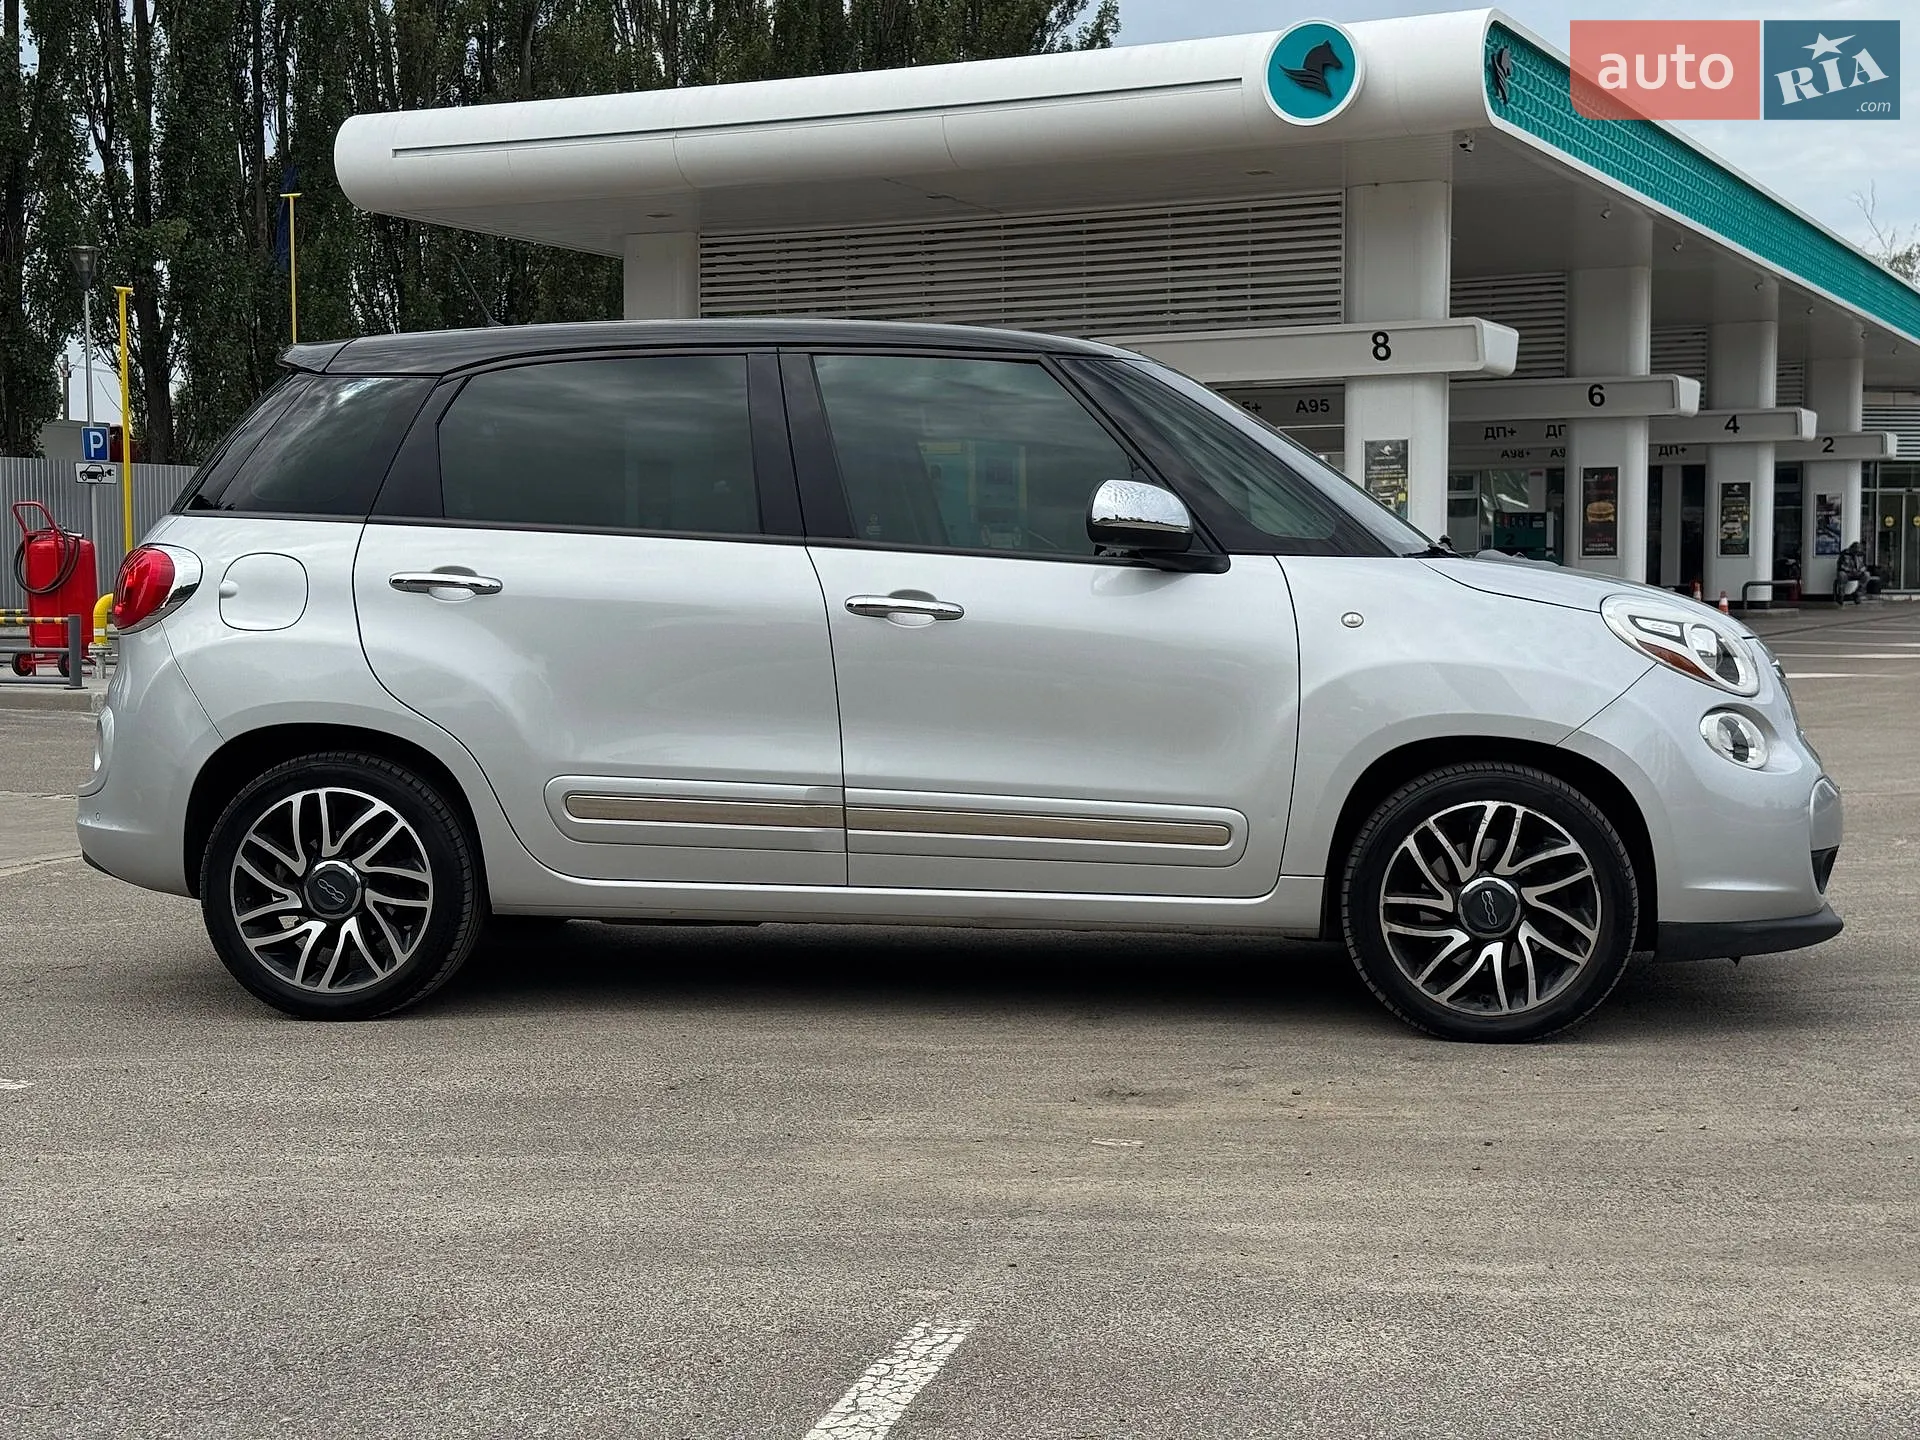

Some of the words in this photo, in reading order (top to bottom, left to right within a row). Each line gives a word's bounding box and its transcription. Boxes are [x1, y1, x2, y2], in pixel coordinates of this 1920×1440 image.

[1371, 331, 1392, 362] 8
[1587, 384, 1606, 408] 6
[1484, 426, 1518, 441] ДП+
[1724, 414, 1740, 434] 4
[89, 431, 104, 458] P
[1658, 445, 1687, 457] ДП+
[1822, 436, 1835, 454] 2
